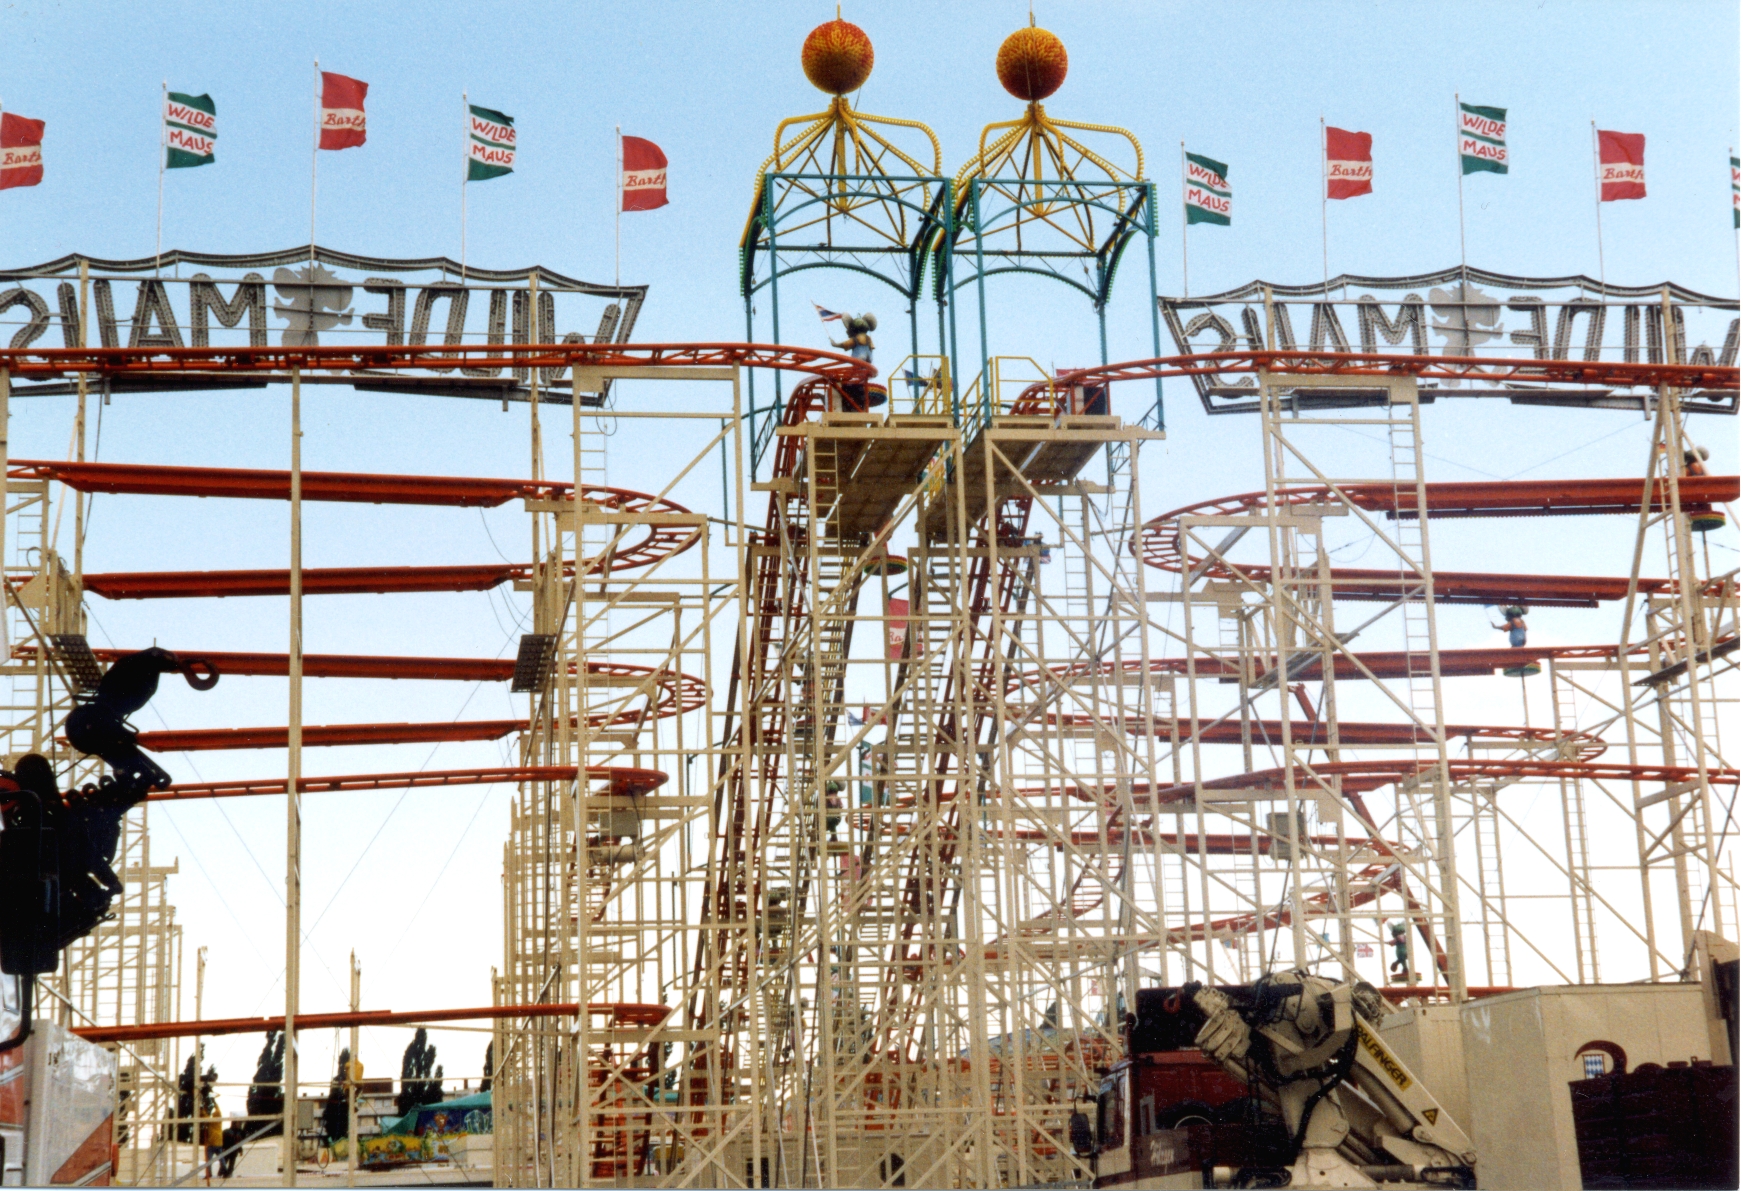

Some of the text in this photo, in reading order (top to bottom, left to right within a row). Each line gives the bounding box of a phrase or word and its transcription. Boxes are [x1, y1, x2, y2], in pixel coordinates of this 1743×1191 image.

[168, 103, 215, 128] WILDE
[1462, 113, 1506, 137] WILDE
[472, 117, 516, 142] WILDE
[170, 130, 213, 155] MAUS
[473, 144, 514, 164] MAUS
[1463, 139, 1506, 160] MAUS
[1188, 189, 1229, 212] MAUS
[1356, 1025, 1407, 1086] PALFINGER
